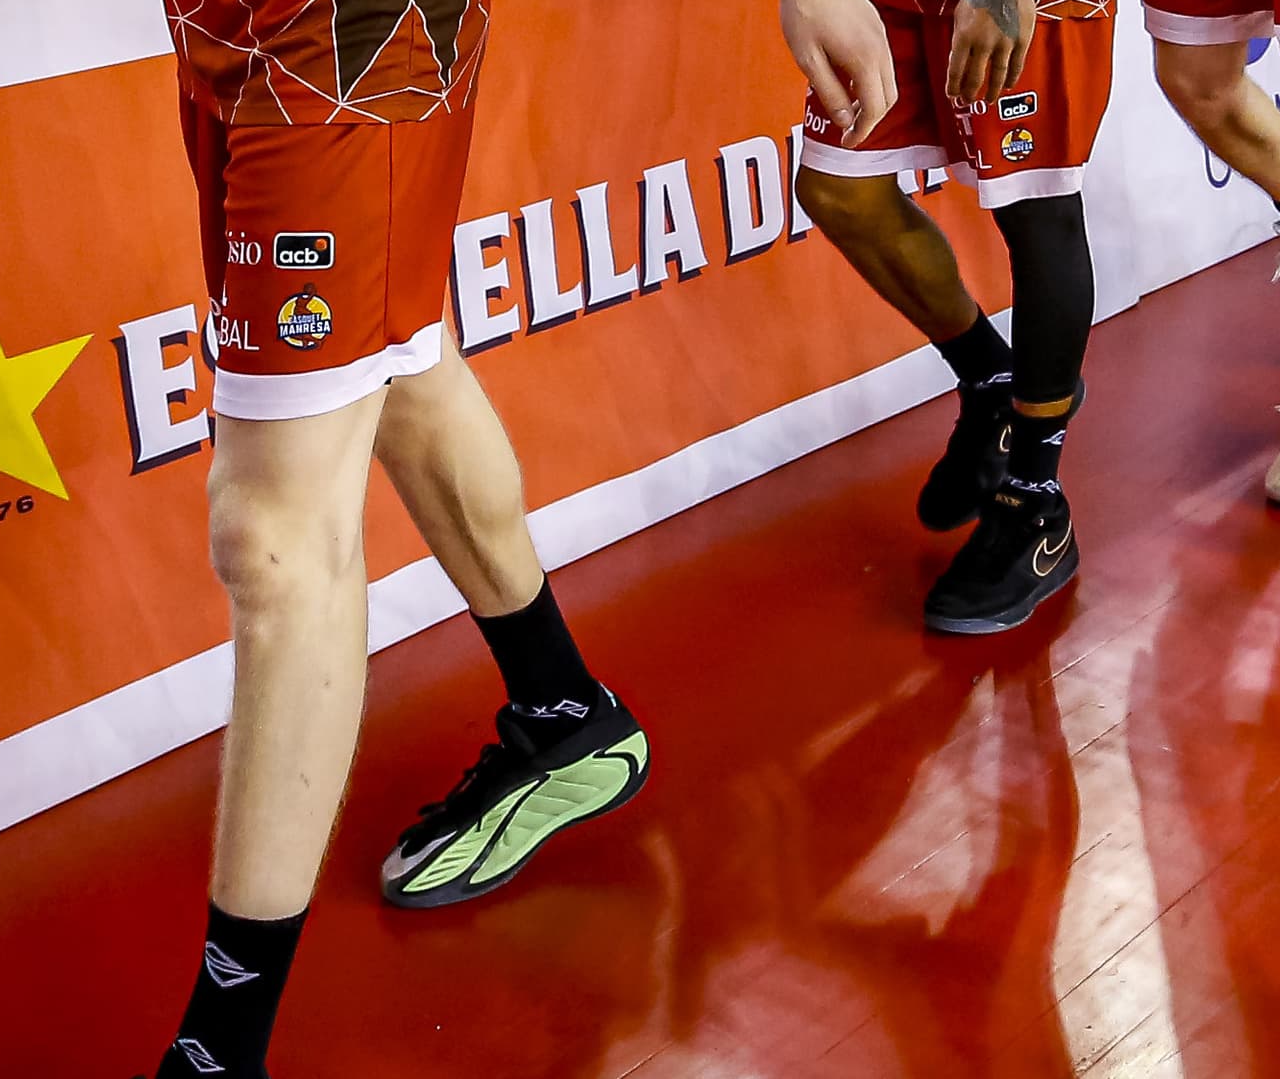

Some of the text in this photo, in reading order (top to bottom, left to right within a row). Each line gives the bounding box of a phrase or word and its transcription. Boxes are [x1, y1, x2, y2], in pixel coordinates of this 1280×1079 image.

[1003, 103, 1028, 118] acb
[279, 247, 319, 264] acb
[279, 321, 331, 338] MANRESA
